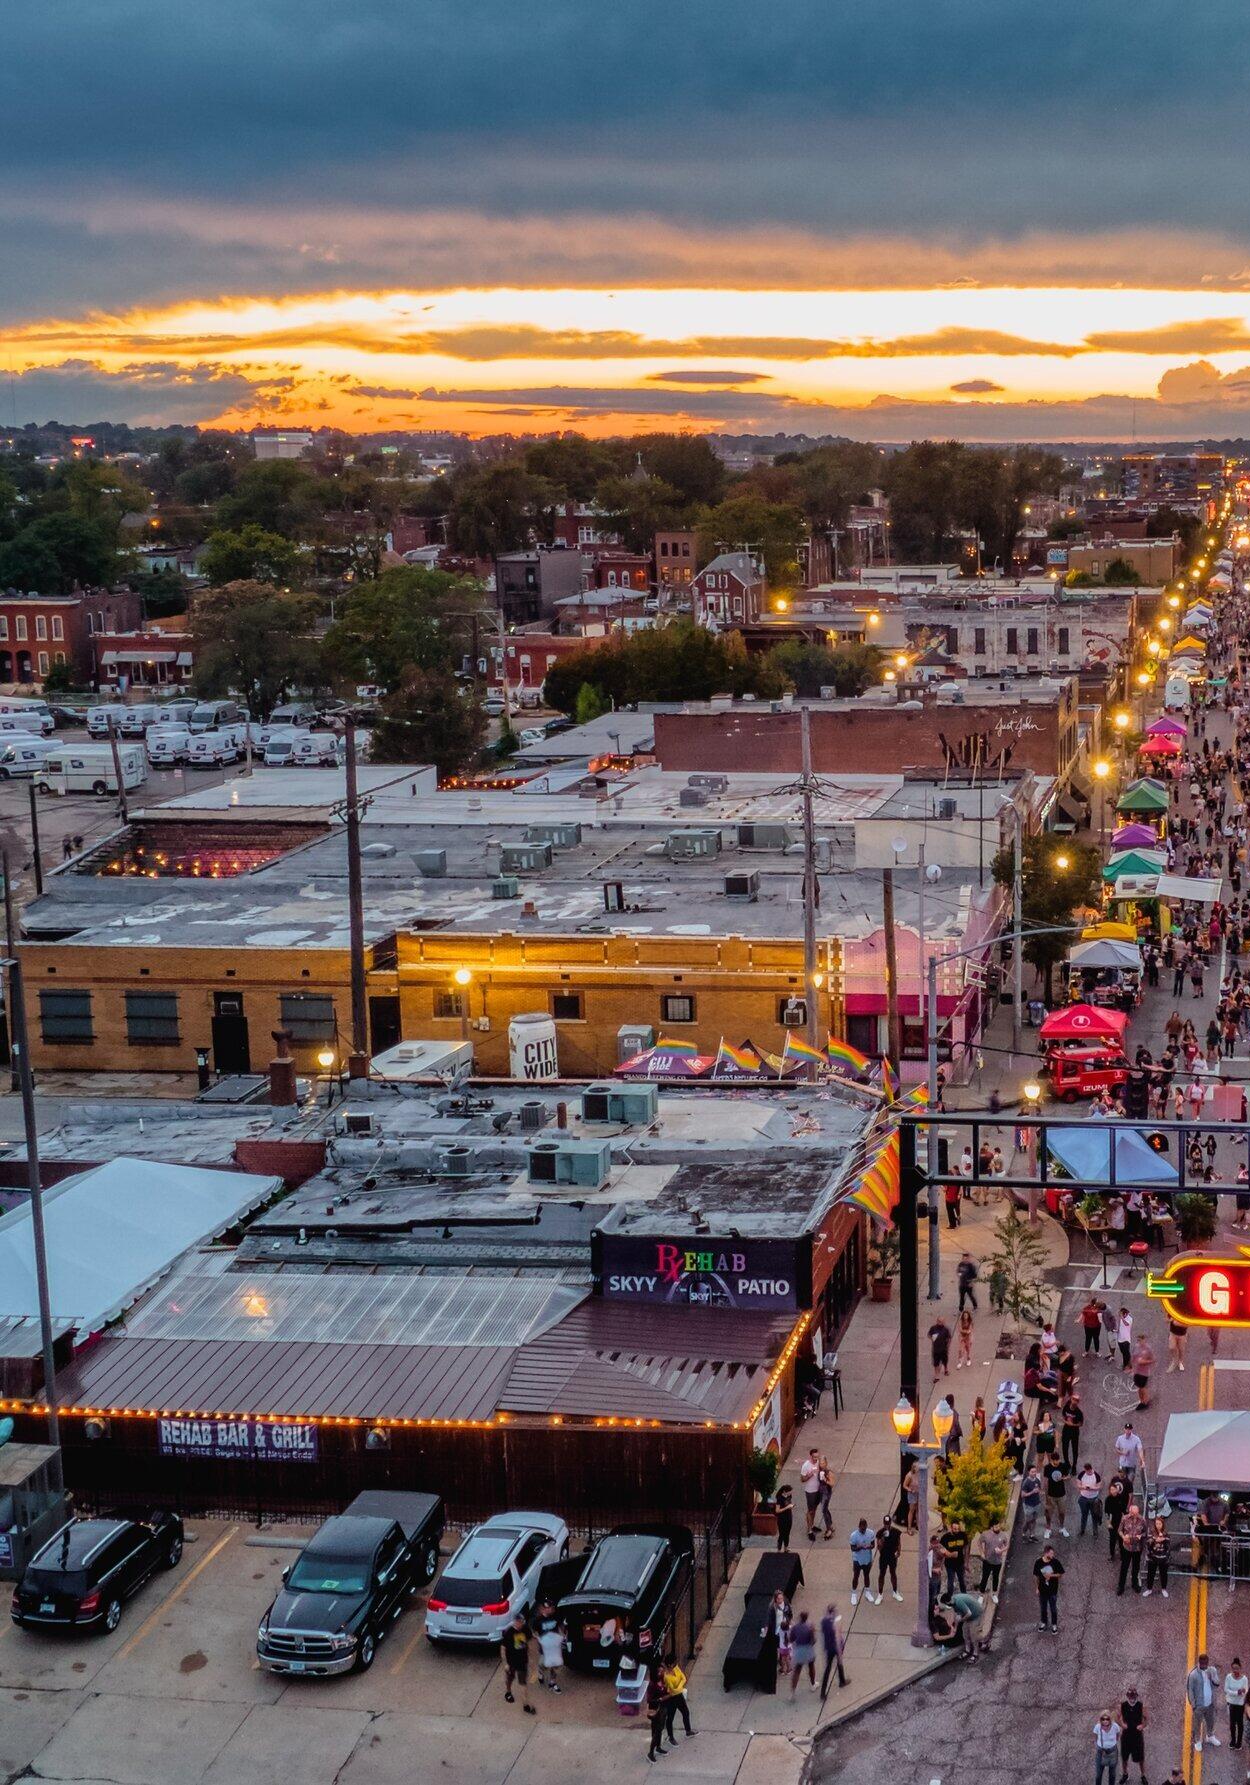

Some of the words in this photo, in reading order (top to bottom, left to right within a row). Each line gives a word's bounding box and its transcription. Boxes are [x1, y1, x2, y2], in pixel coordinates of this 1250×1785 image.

[524, 1036, 556, 1064] CITY
[523, 1059, 558, 1079] WIDE
[609, 1275, 658, 1292] SKYY
[738, 1278, 790, 1296] PATIO
[161, 1420, 212, 1445] REHAB
[217, 1423, 249, 1447] BAR
[255, 1425, 266, 1448] &
[272, 1425, 314, 1449] GRILL
